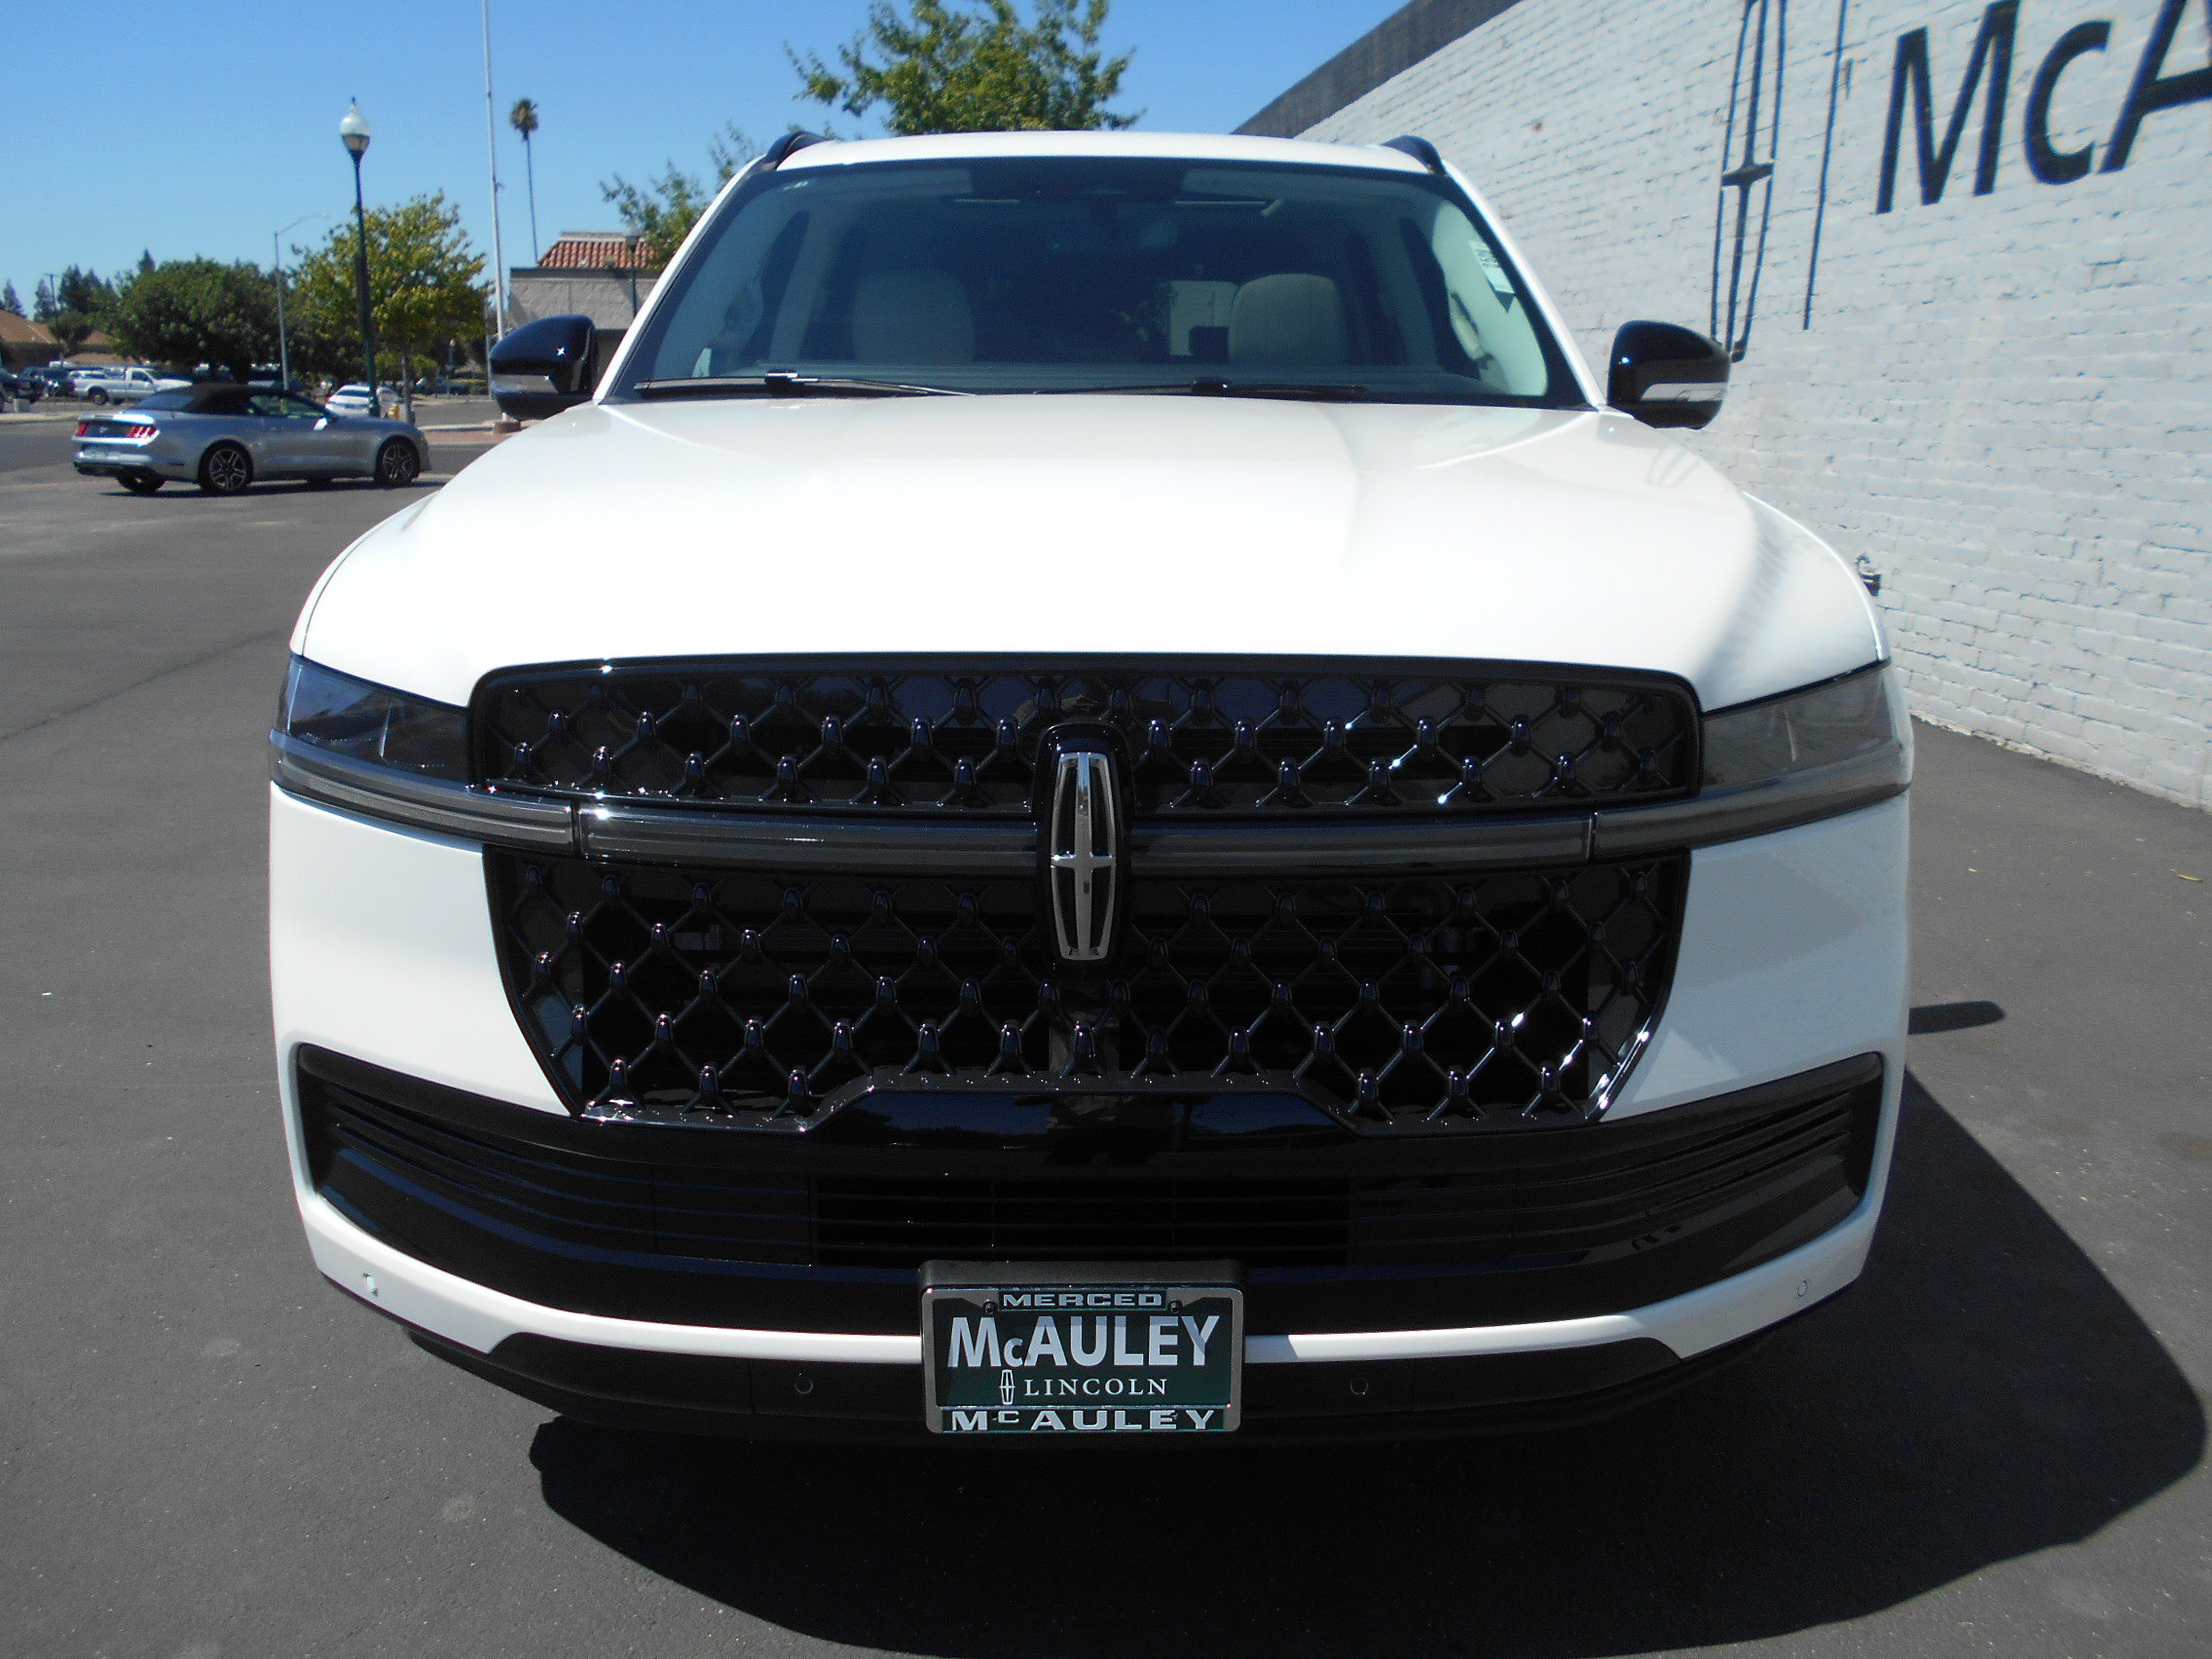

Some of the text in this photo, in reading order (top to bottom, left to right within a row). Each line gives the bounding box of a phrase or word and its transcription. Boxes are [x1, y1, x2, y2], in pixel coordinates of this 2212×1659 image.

[1003, 1293, 1162, 1307] MERCED
[947, 1315, 1220, 1368] McAULEY
[1024, 1379, 1168, 1396] LINCOLN
